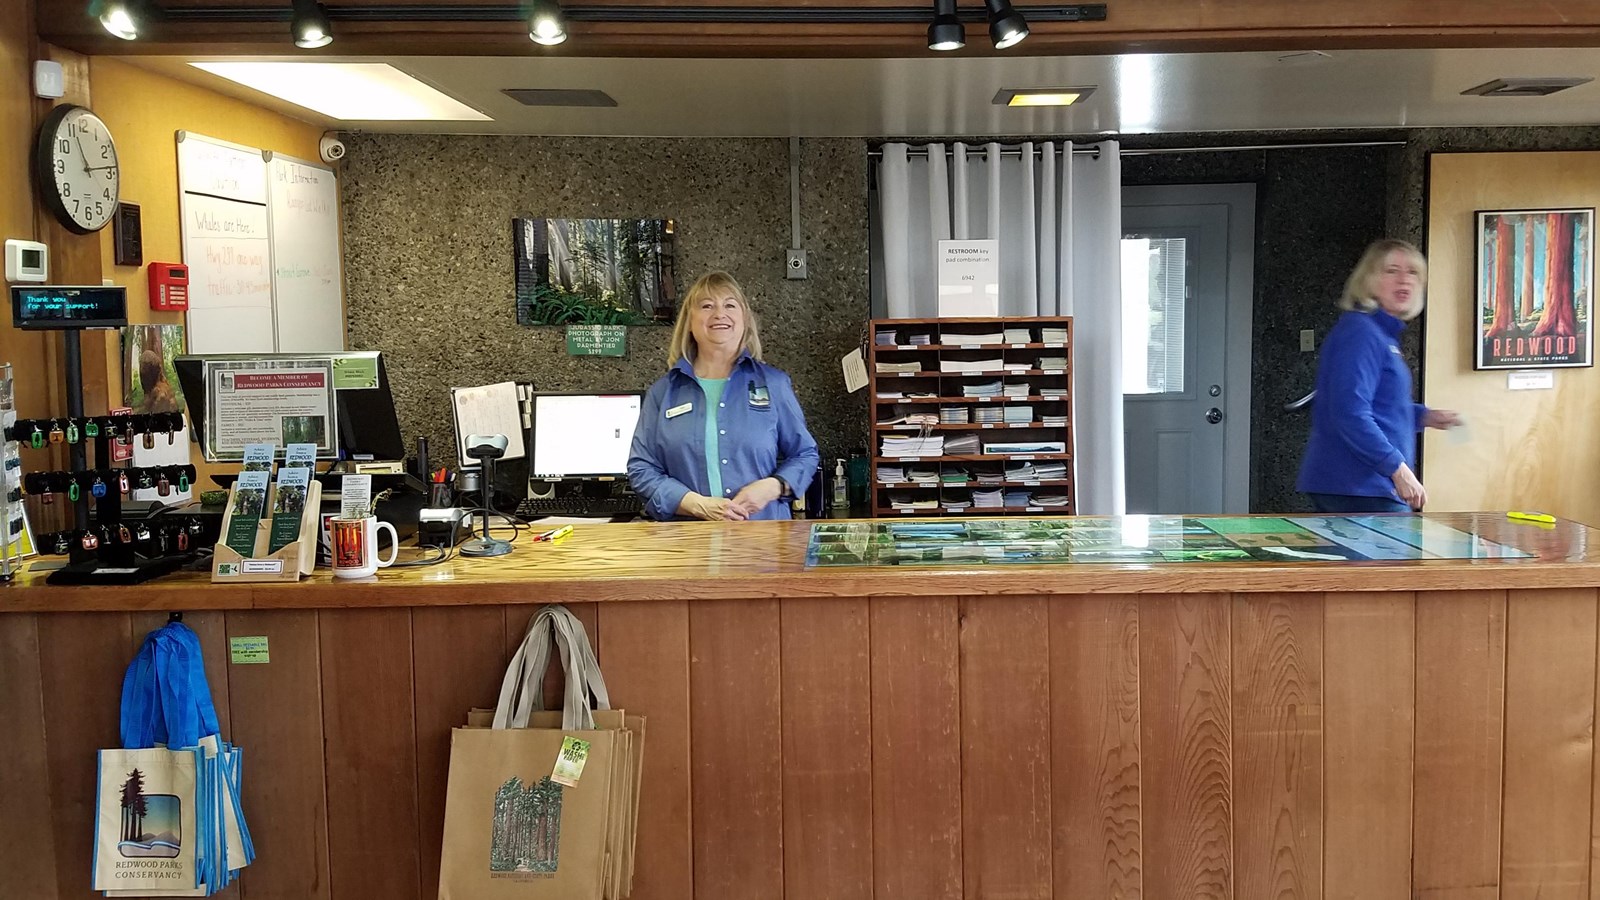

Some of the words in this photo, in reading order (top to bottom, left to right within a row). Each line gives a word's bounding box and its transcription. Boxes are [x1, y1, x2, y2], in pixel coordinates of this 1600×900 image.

[68, 123, 76, 138] 11
[79, 119, 89, 133] 12
[59, 140, 70, 154] 10
[101, 145, 108, 159] 2
[57, 160, 65, 174] 9
[106, 167, 113, 180] 3
[63, 183, 71, 197] 8
[103, 188, 110, 201] 4
[73, 200, 79, 213] 7
[85, 206, 92, 220] 6
[95, 202, 103, 216] 5
[195, 210, 221, 232] Whales
[224, 220, 235, 233] are
[1493, 336, 1576, 357] REDWOOD
[116, 860, 158, 868] REDWOOD
[160, 861, 183, 869] PARKS
[115, 871, 182, 879] CONSERVANCY
